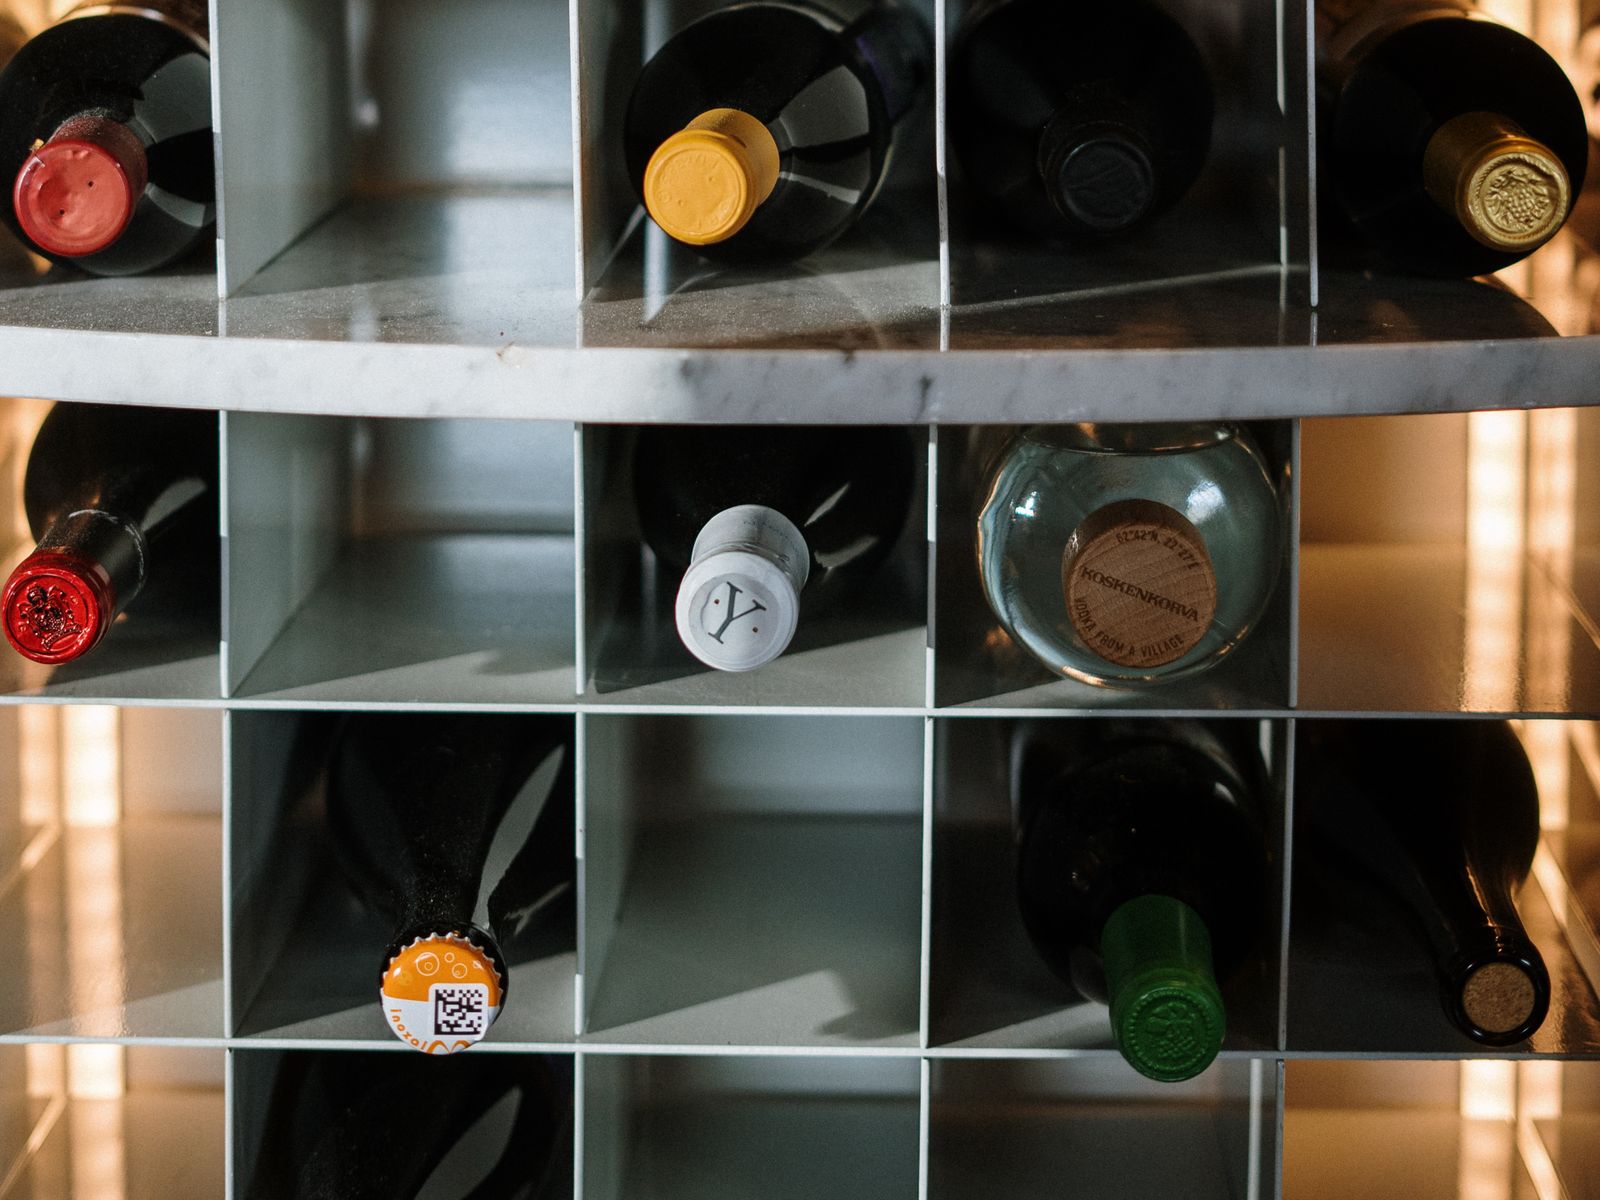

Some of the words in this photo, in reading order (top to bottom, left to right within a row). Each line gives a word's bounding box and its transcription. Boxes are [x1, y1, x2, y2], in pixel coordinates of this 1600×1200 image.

[708, 581, 766, 645] Y
[1080, 566, 1199, 622] KOSKENKORVA
[1074, 596, 1097, 633] VODKA
[1095, 631, 1125, 652] FROM
[1129, 646, 1136, 656] A
[1141, 634, 1185, 657] VILLAGE
